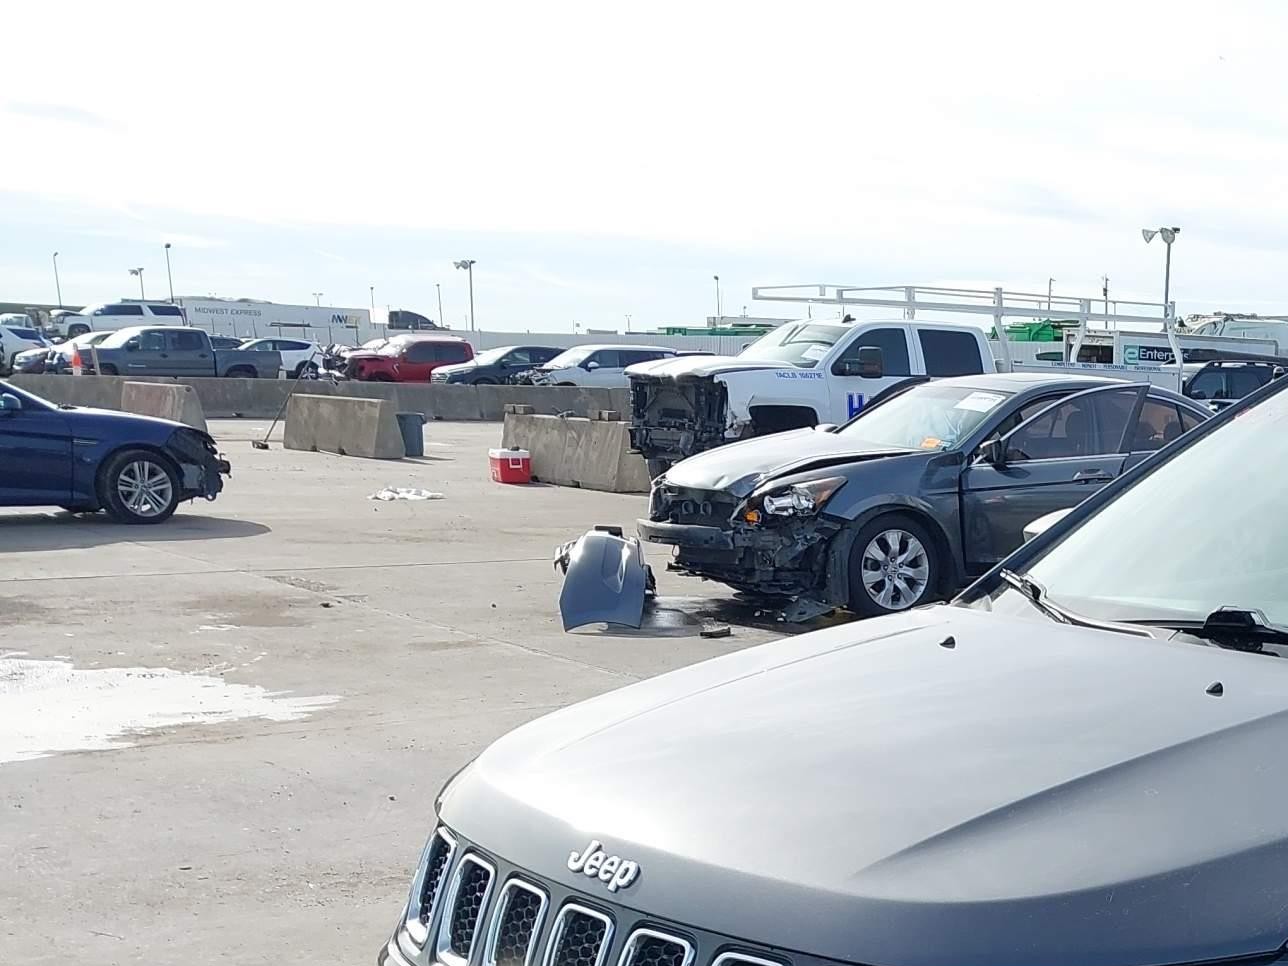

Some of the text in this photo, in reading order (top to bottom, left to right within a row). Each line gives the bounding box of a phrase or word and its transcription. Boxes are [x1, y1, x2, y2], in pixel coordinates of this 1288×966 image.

[194, 306, 262, 317] MIDWEST EXPRESS
[567, 839, 641, 893] Jeep
